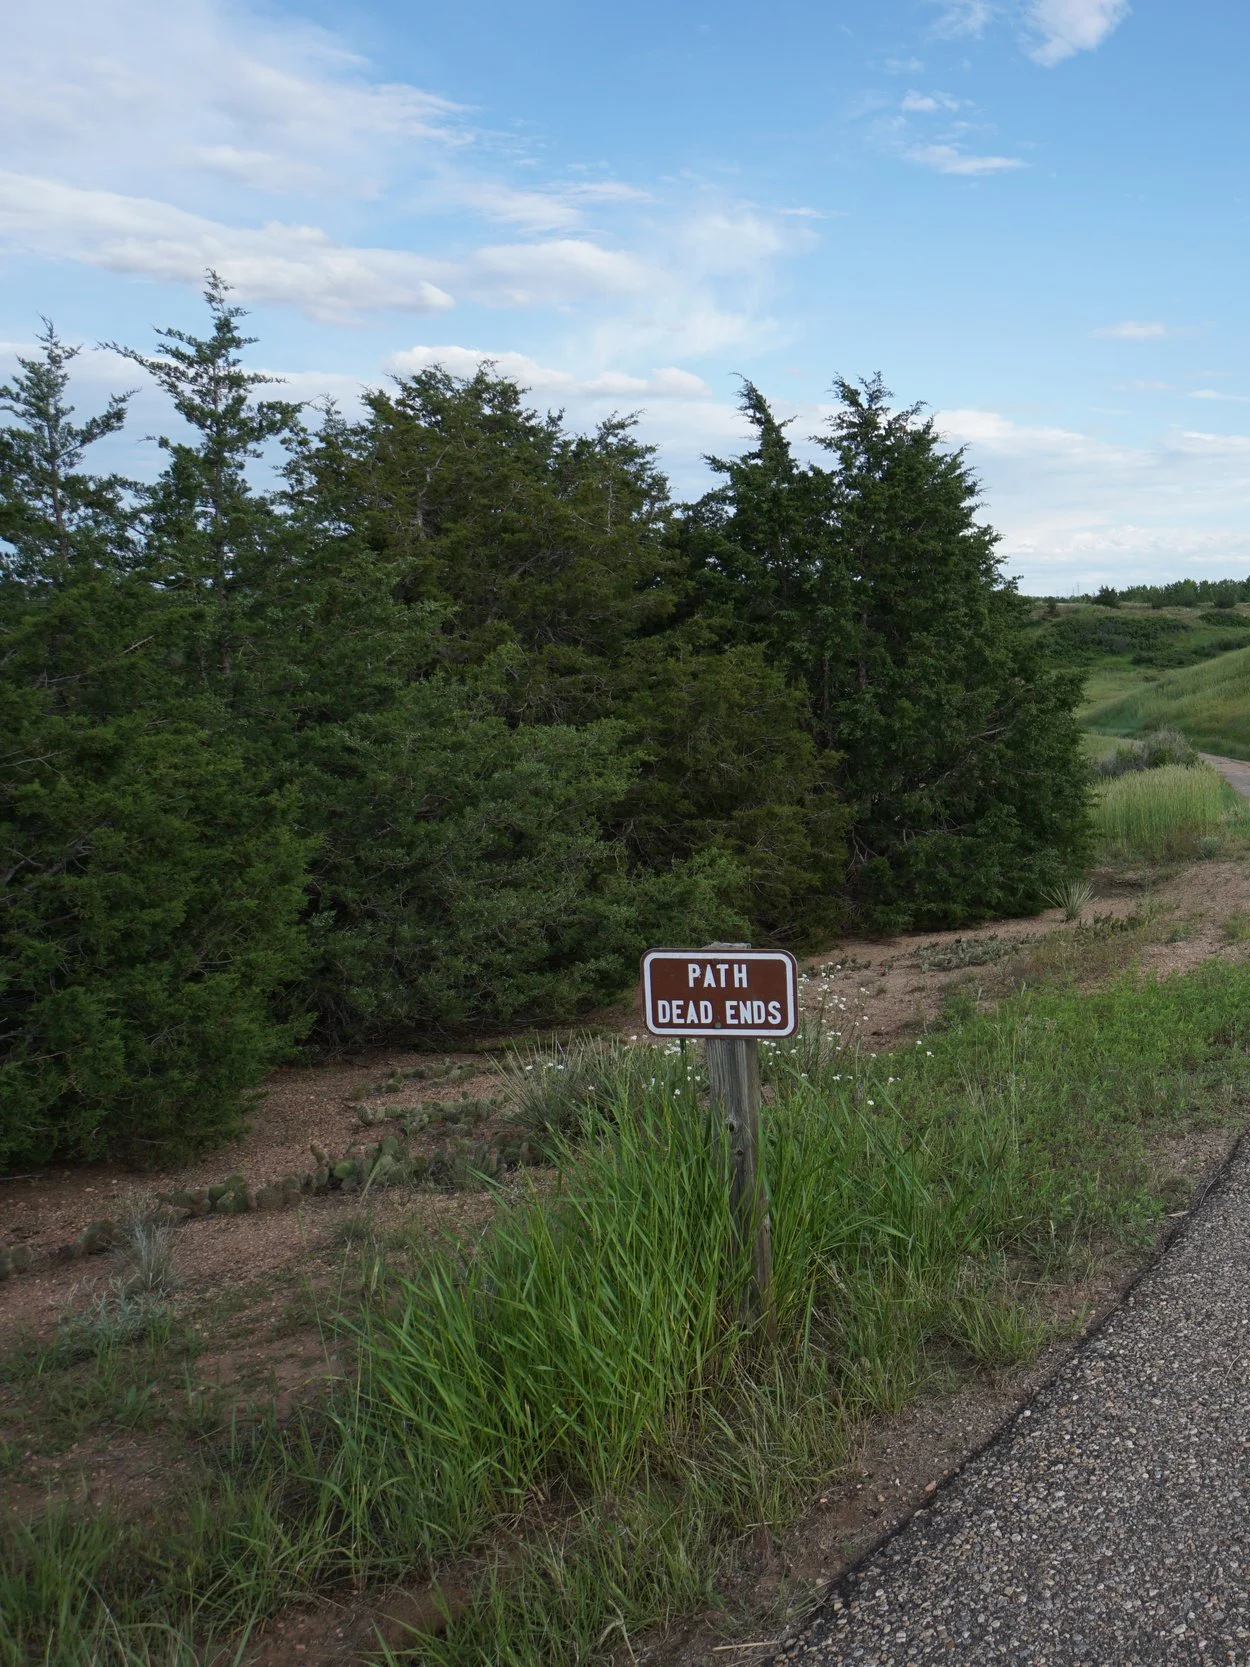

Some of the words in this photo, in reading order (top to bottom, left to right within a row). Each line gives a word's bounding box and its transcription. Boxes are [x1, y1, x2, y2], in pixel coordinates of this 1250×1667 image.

[688, 963, 748, 988] PATH
[657, 1000, 713, 1024] DEAD
[725, 1000, 782, 1025] ENDS
